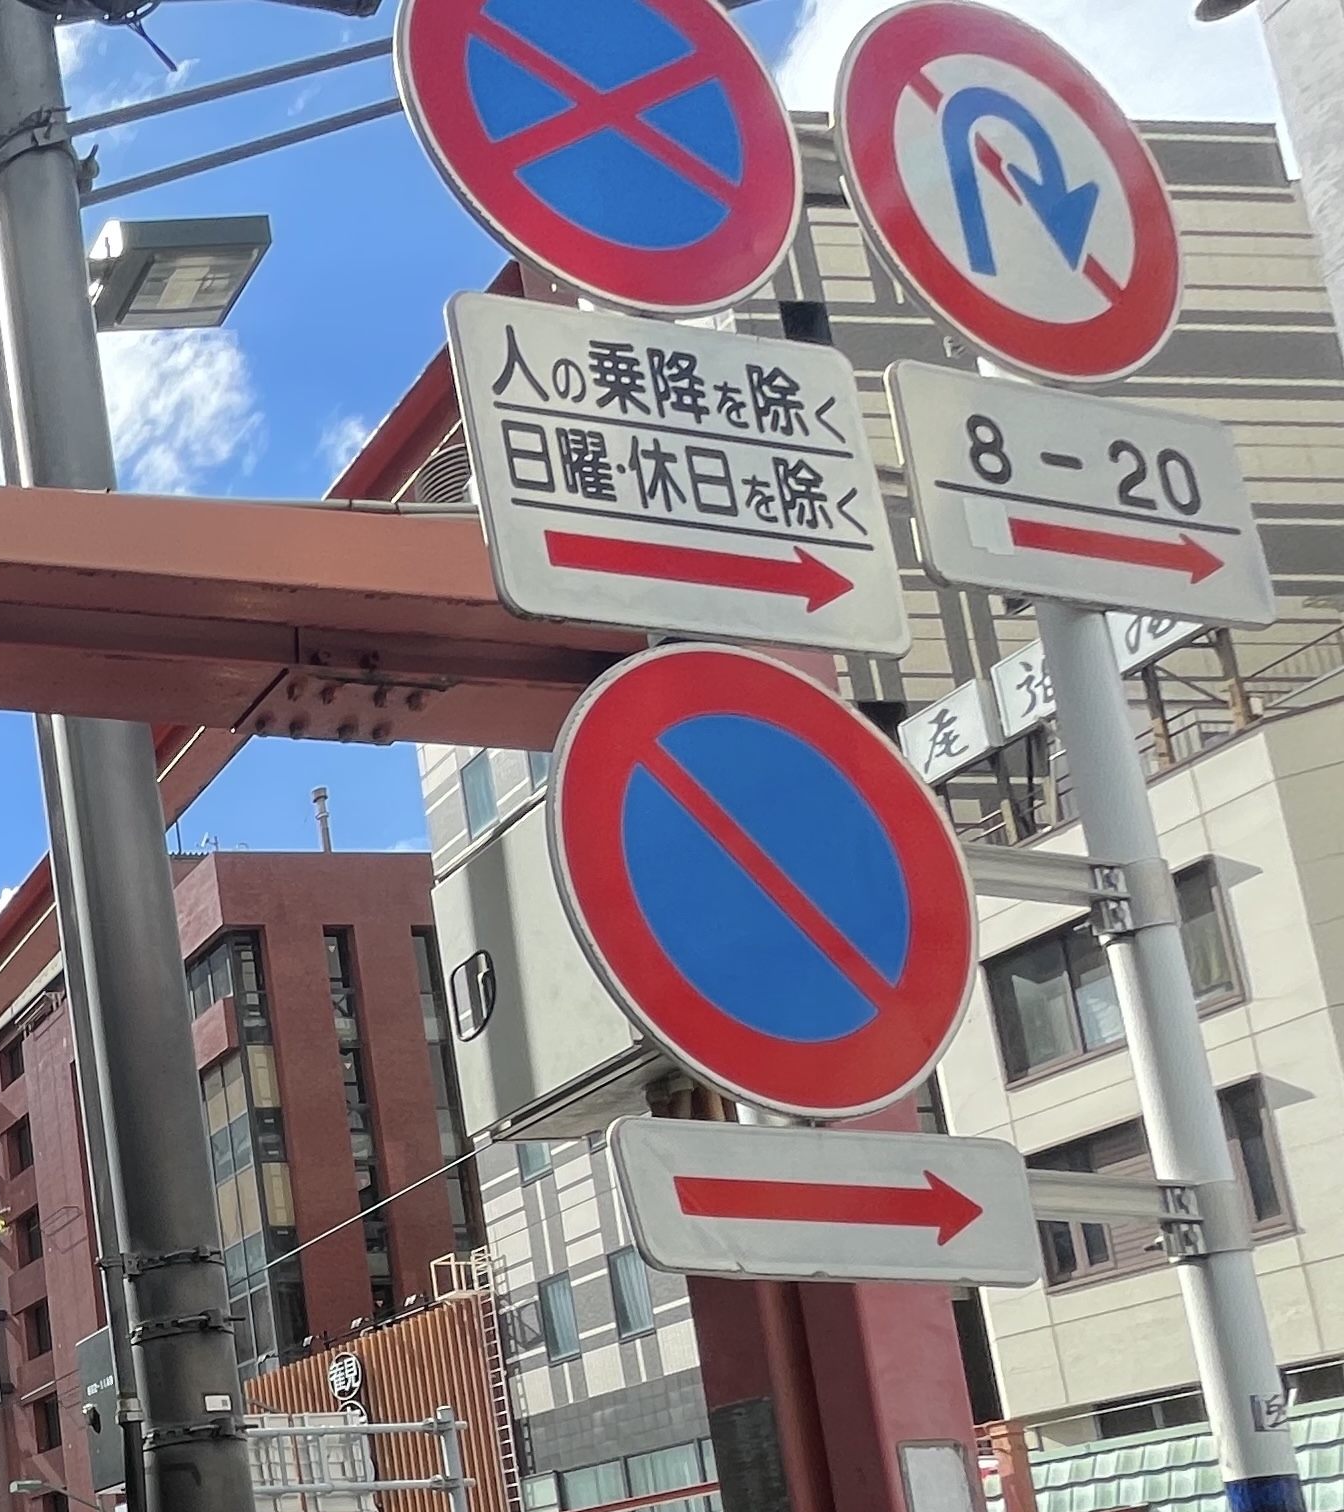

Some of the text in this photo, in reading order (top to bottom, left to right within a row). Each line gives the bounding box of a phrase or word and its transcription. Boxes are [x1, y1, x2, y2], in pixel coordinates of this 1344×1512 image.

[491, 324, 846, 444] 人の乗降を除く
[500, 419, 868, 536] 日曜・休日を除く
